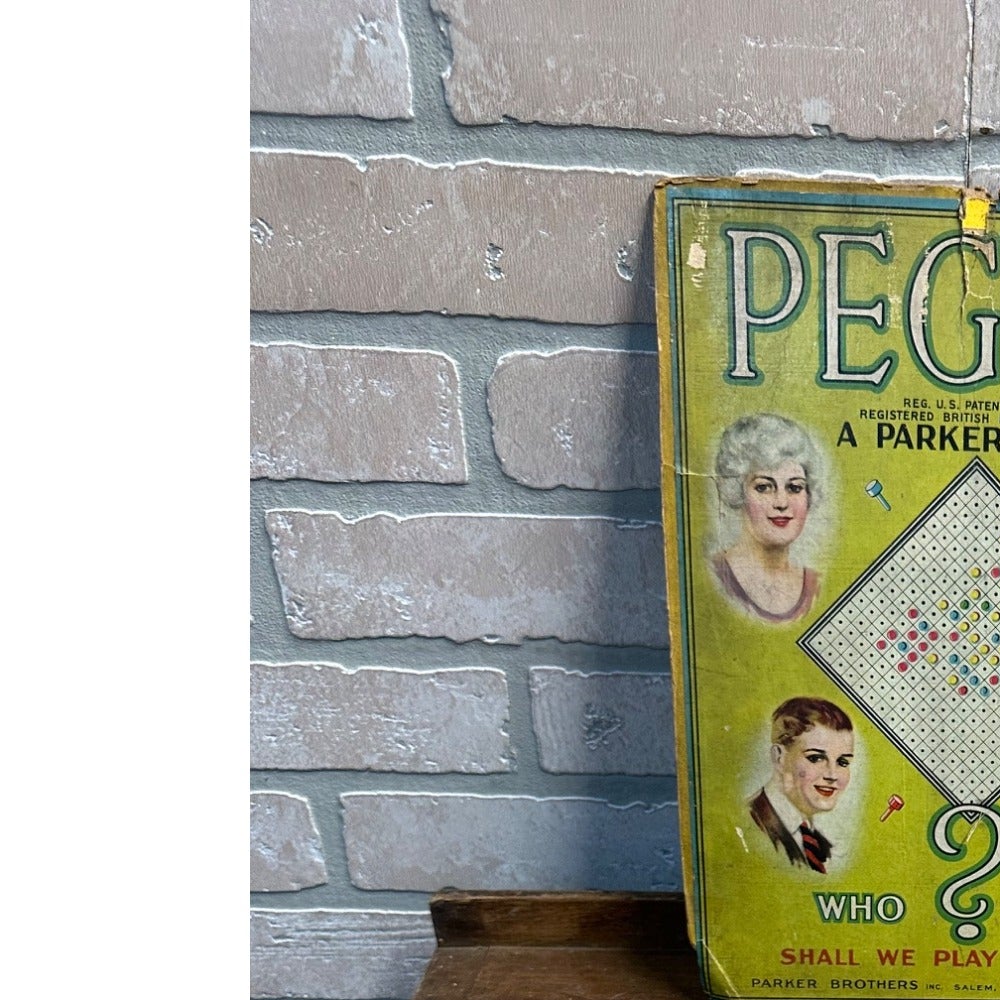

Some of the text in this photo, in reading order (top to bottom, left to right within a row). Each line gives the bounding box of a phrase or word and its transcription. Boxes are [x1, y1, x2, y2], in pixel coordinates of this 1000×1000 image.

[903, 398, 931, 408] REG.
[860, 410, 934, 422] REGISTERED
[943, 413, 989, 424] BRITISH
[837, 421, 857, 448] A
[815, 893, 906, 924] WHO
[780, 947, 860, 966] SHALL
[876, 948, 916, 967] WE
[933, 949, 999, 968] PLAY
[751, 978, 818, 989] PARKER
[830, 978, 919, 990] BROTHERS
